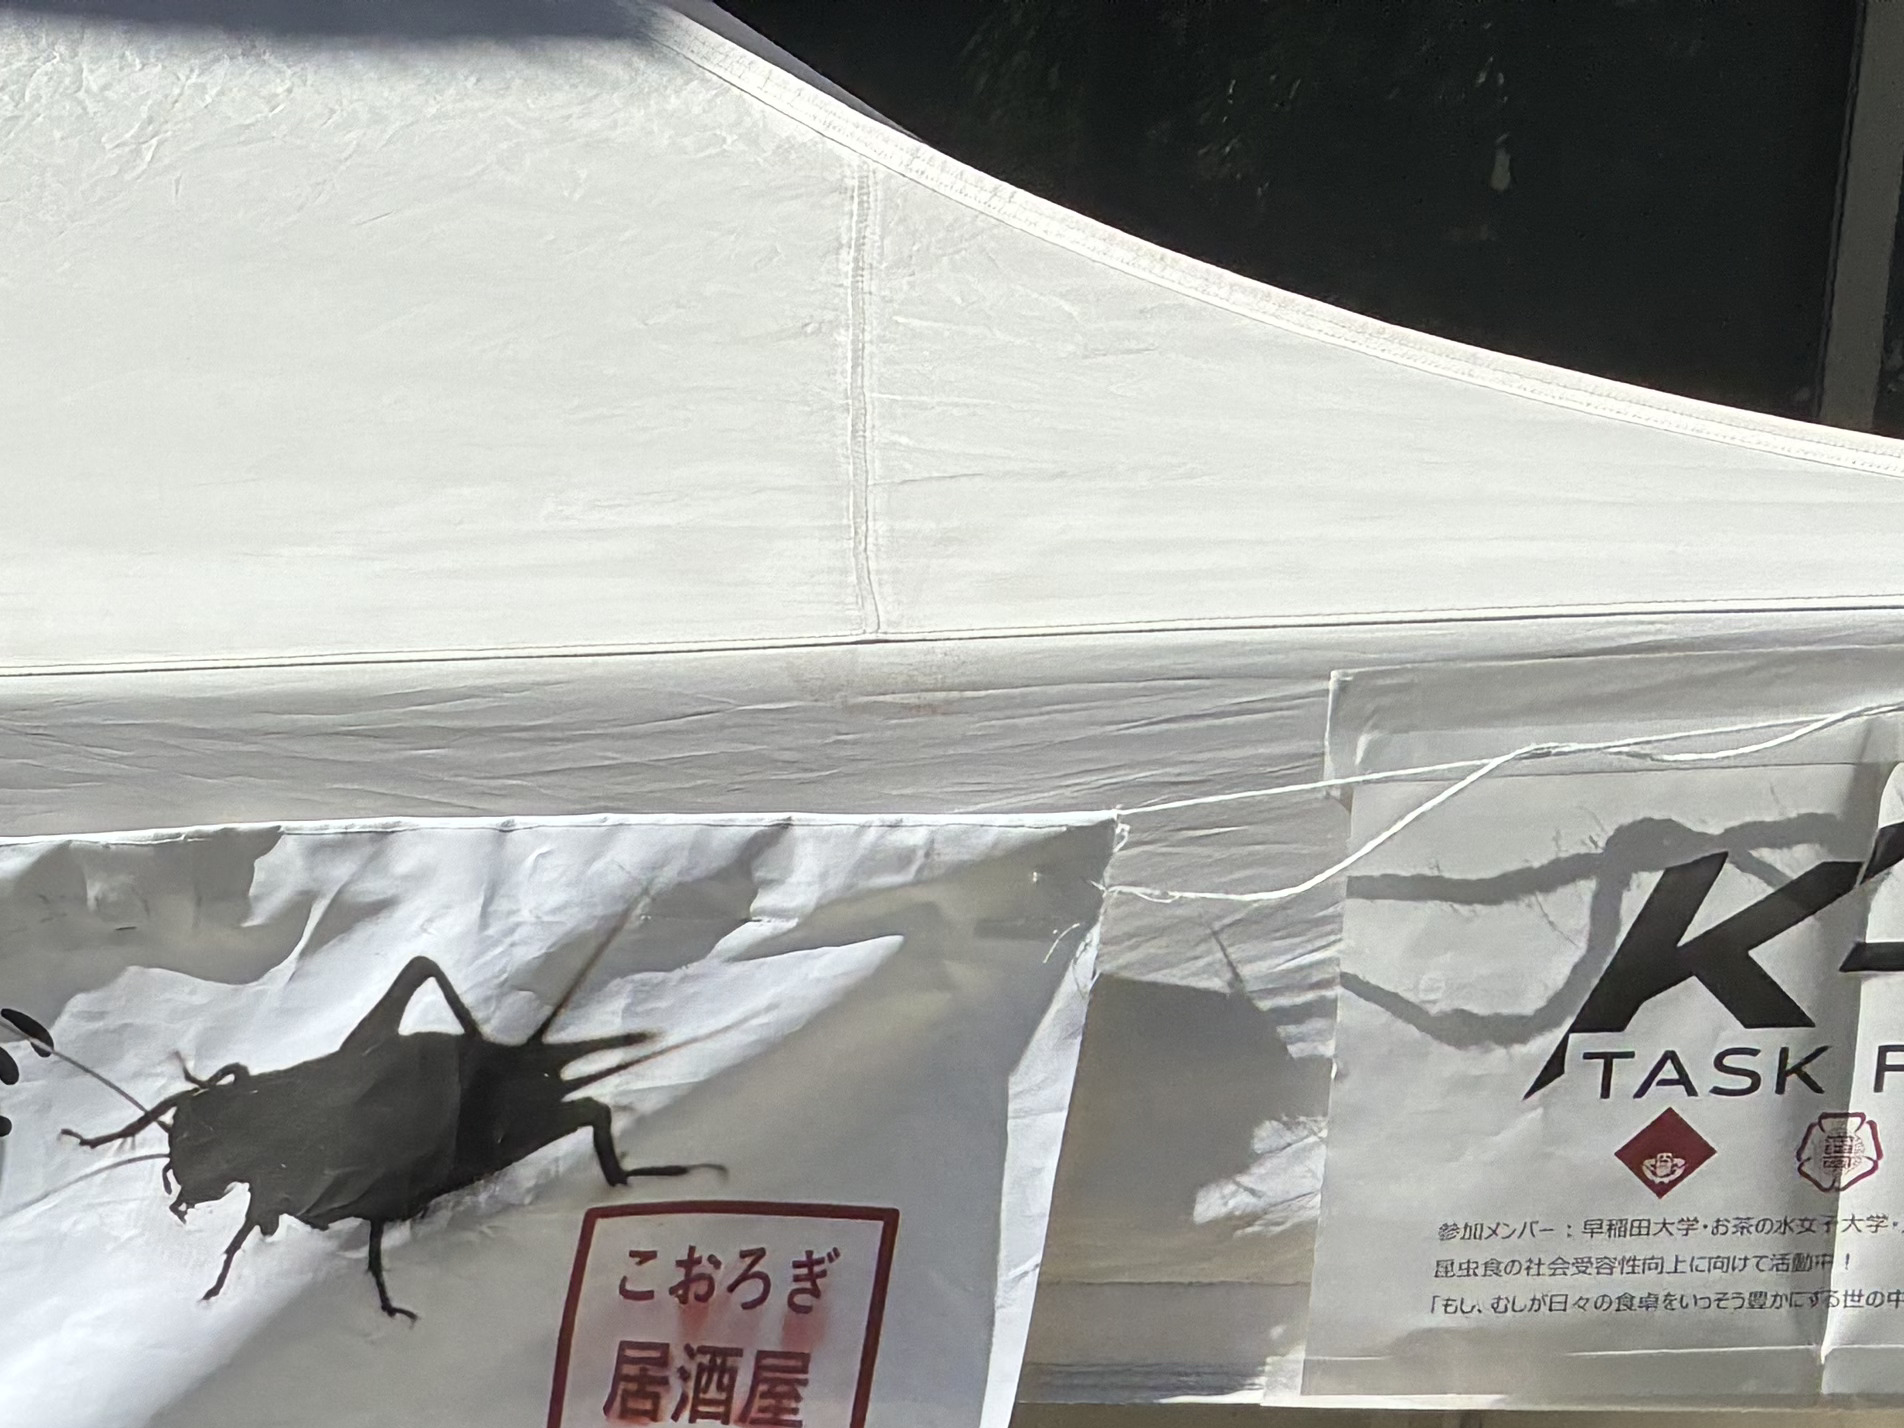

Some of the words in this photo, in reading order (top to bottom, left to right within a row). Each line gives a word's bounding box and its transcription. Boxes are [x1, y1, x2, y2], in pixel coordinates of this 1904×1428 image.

[1582, 1046, 1831, 1099] TASK
[618, 1245, 840, 1314] こおろぎ
[603, 1340, 812, 1428] 居酒屋
